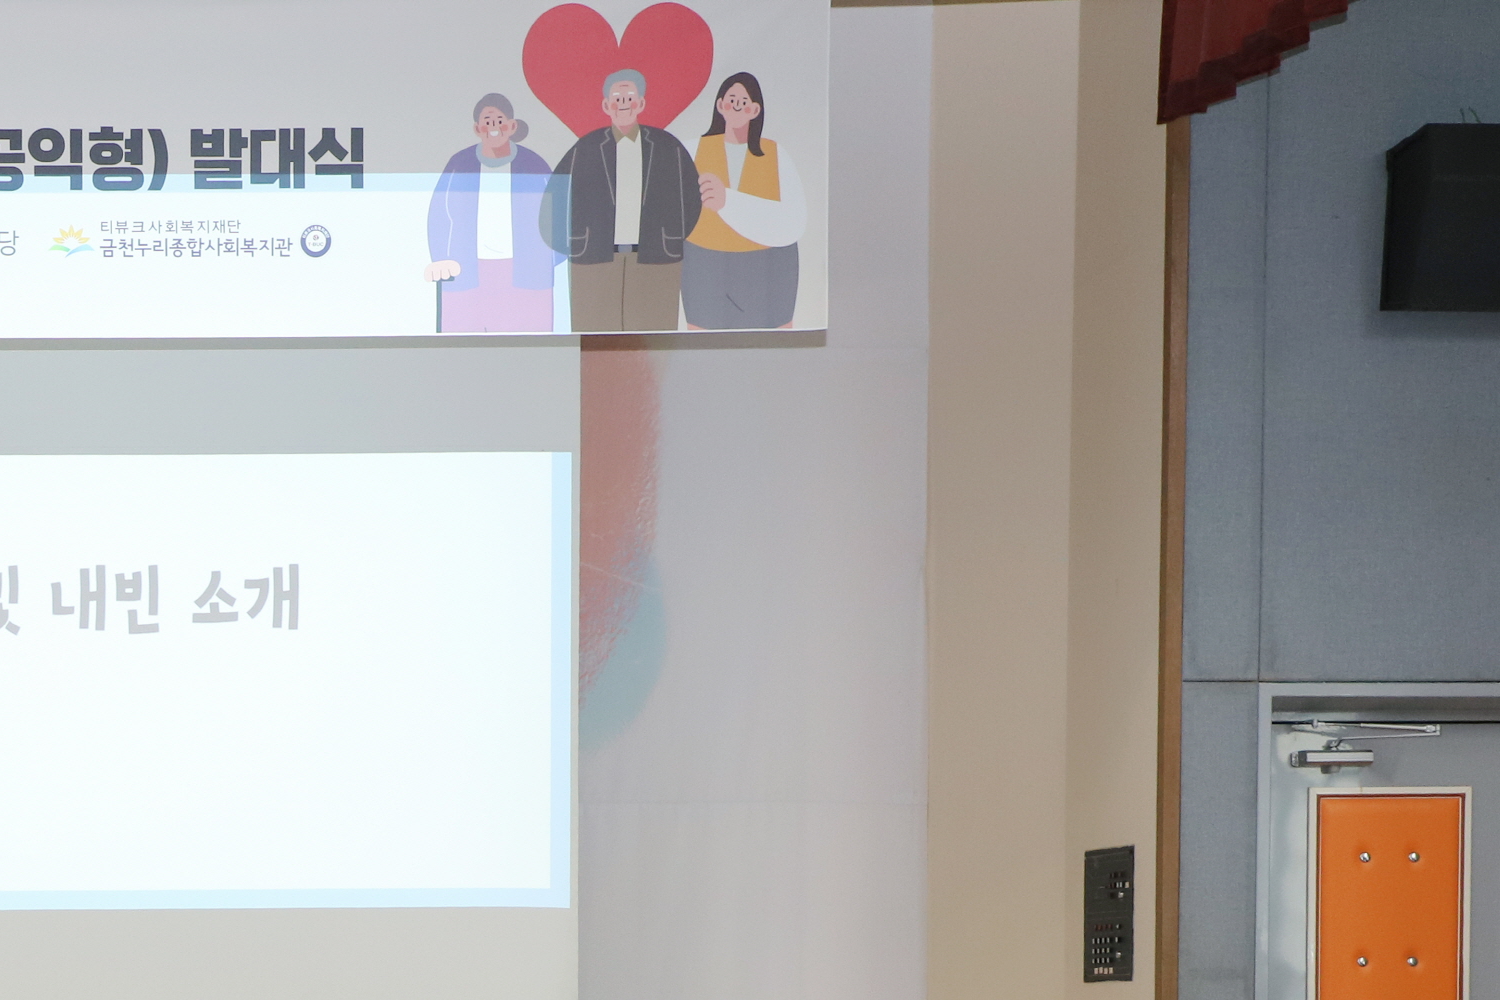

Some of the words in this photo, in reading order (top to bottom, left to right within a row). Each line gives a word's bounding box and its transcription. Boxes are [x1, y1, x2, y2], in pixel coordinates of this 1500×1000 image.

[190, 126, 366, 190] 발대식
[99, 237, 293, 258] 금천누리종합사회복지관
[100, 219, 241, 234] 티뷰크사회복지재단
[51, 565, 159, 634] 내빈
[192, 564, 299, 630] 소개
